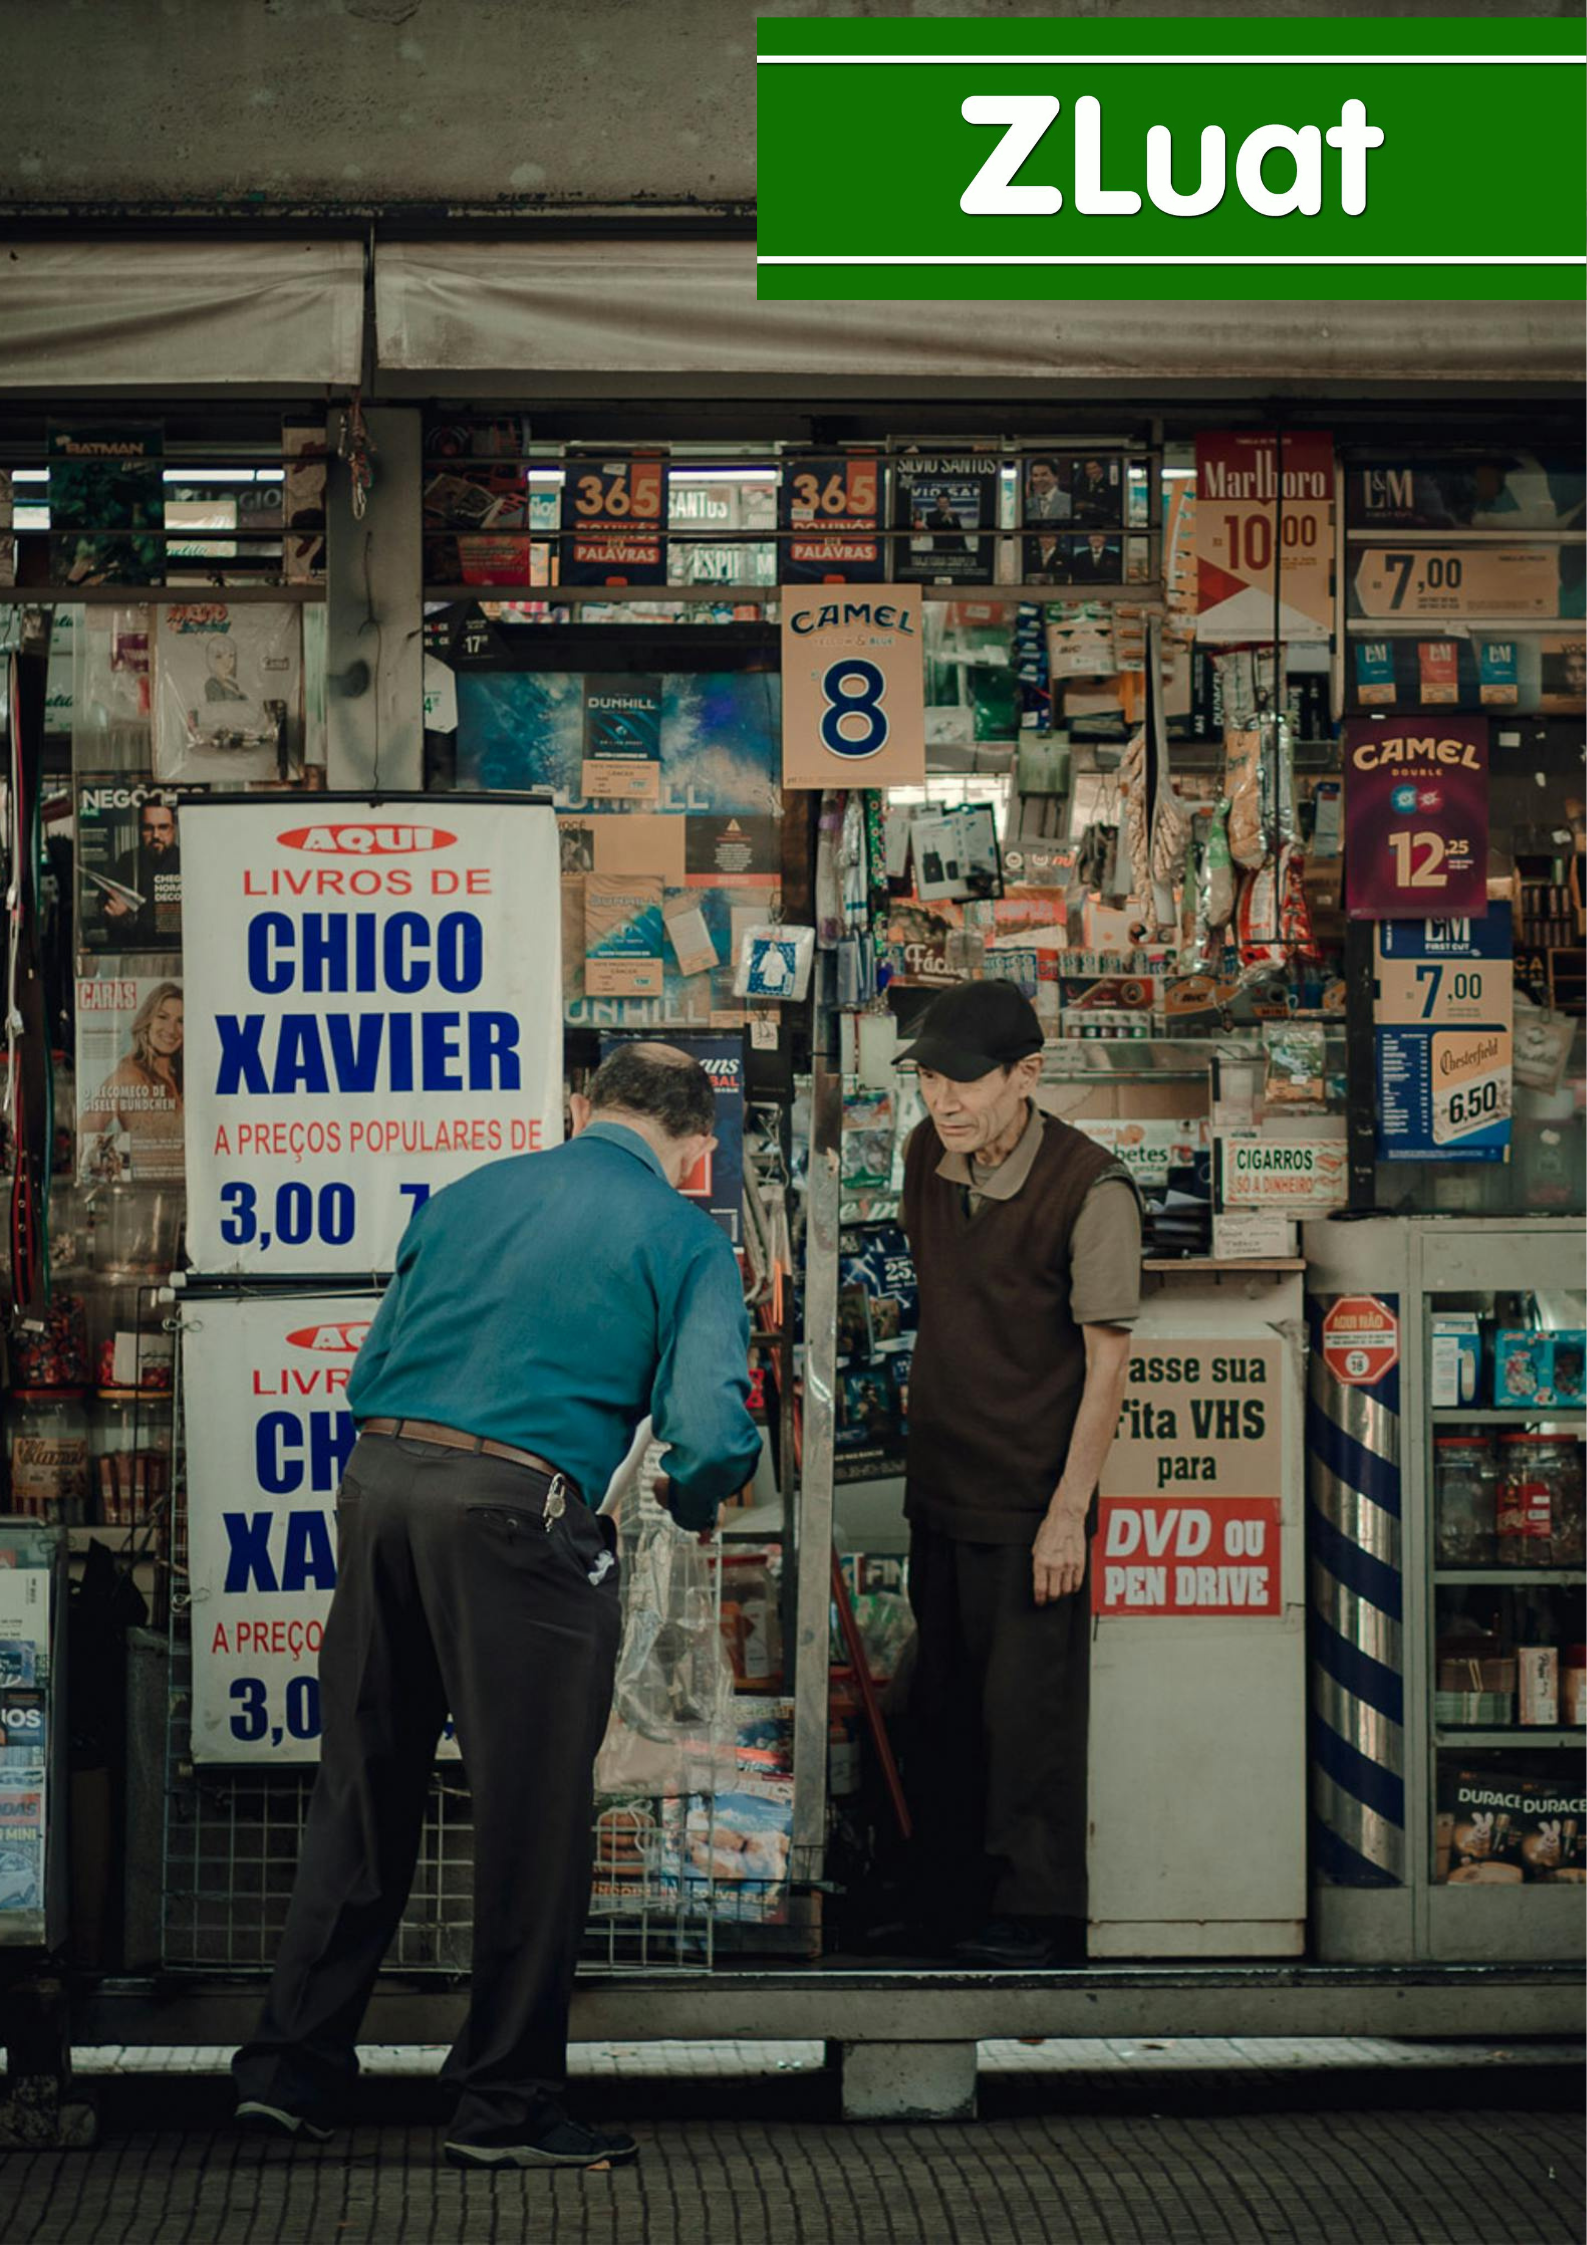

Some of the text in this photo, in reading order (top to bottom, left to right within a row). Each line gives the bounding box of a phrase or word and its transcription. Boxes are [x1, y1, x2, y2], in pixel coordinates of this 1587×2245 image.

[65, 441, 144, 456] BATMAN
[1204, 450, 1326, 498] Marlboro
[575, 475, 659, 516] 365
[792, 473, 875, 514] 365
[578, 546, 656, 561] PALAVRAS
[794, 545, 873, 559] PALAVRAS
[791, 604, 915, 635] CAMEL
[588, 697, 657, 709] DUNHILL
[820, 659, 889, 758] 8
[1352, 737, 1482, 770] CAMEL
[302, 827, 435, 854] AQUI
[243, 868, 492, 896] LIVROS DE
[248, 911, 483, 993] CHICO
[80, 983, 136, 1010] CARAS
[215, 1011, 521, 1095] XAVIER
[1440, 1038, 1498, 1076] Chesterfield
[1450, 1081, 1497, 1125] 6,50
[214, 1119, 542, 1163] A PREÇOS POPULARES DE
[1237, 1149, 1313, 1170] CIGARROS
[1264, 1176, 1313, 1193] DINHEIRO
[220, 1181, 355, 1251] 3,00
[1359, 1311, 1384, 1329] NÃO
[1212, 1357, 1267, 1383] sua
[1190, 1398, 1266, 1440] VHS
[1157, 1455, 1217, 1488] para
[1105, 1508, 1266, 1557] DVD OU
[1104, 1566, 1269, 1606] PEN DRIVE
[212, 1620, 323, 1662] A PREÇO
